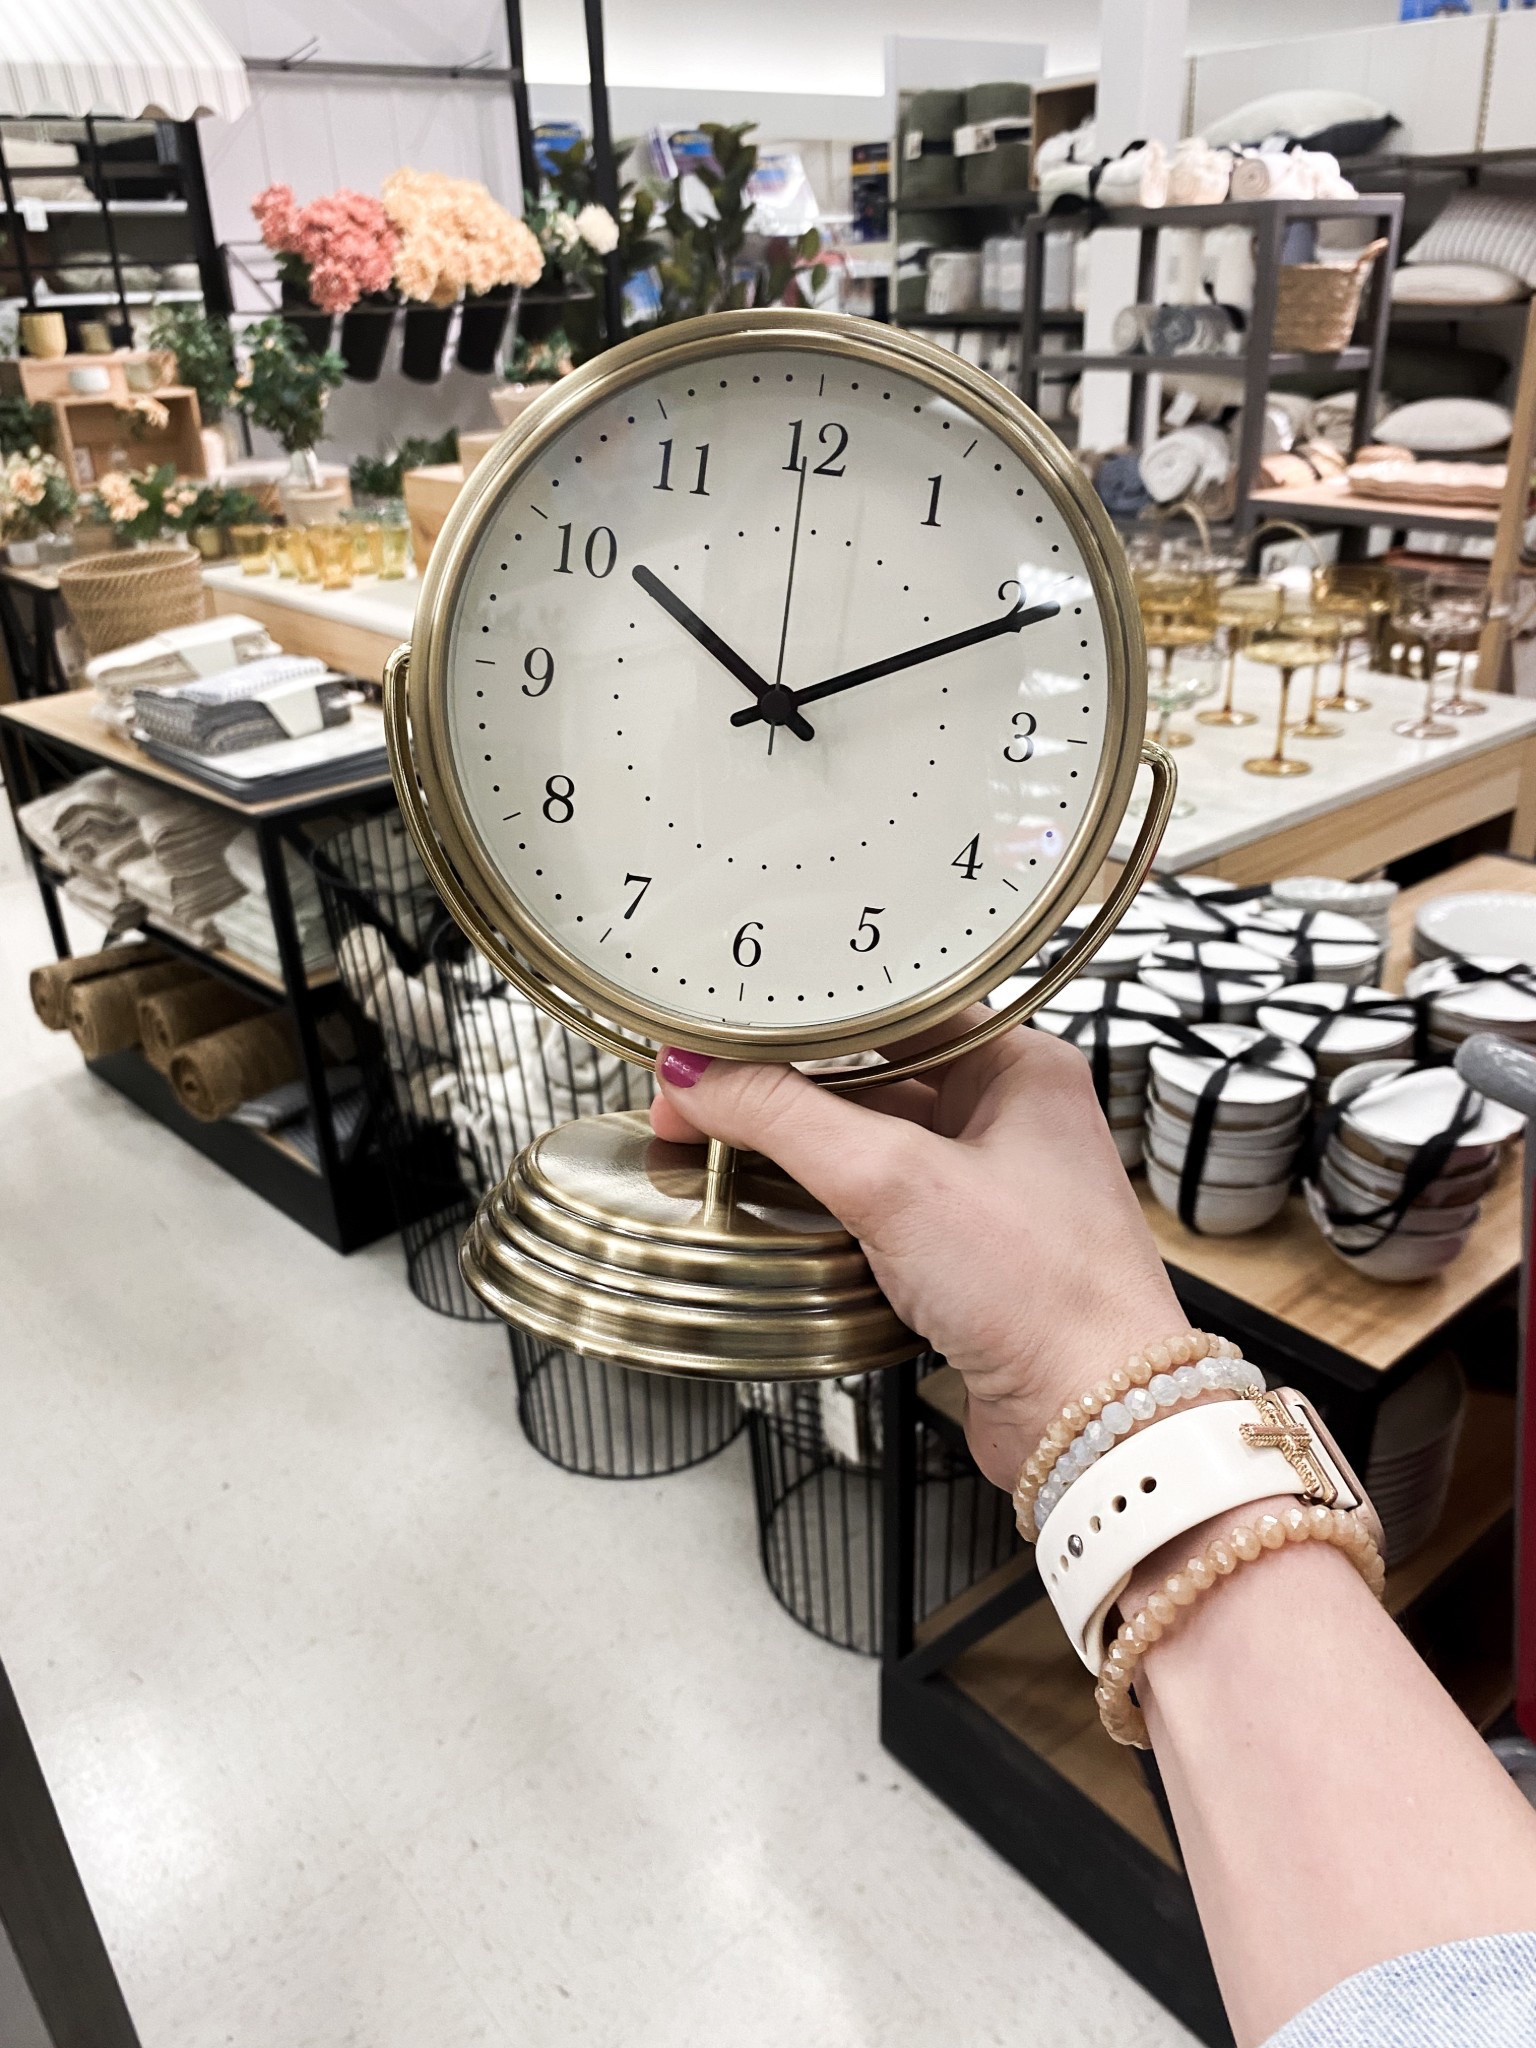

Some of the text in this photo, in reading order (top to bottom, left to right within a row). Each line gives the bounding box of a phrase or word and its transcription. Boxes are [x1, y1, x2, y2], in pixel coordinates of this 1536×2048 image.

[652, 438, 711, 497] 11
[781, 419, 849, 478] 12
[919, 474, 943, 528] 1
[553, 522, 618, 579] 10
[998, 580, 1028, 633] 2
[521, 646, 555, 698] 9
[1003, 711, 1038, 763] 3
[542, 774, 576, 824] 8
[950, 832, 984, 881] 4
[623, 872, 653, 921] 7
[733, 921, 764, 968] 6
[849, 906, 887, 953] 5
